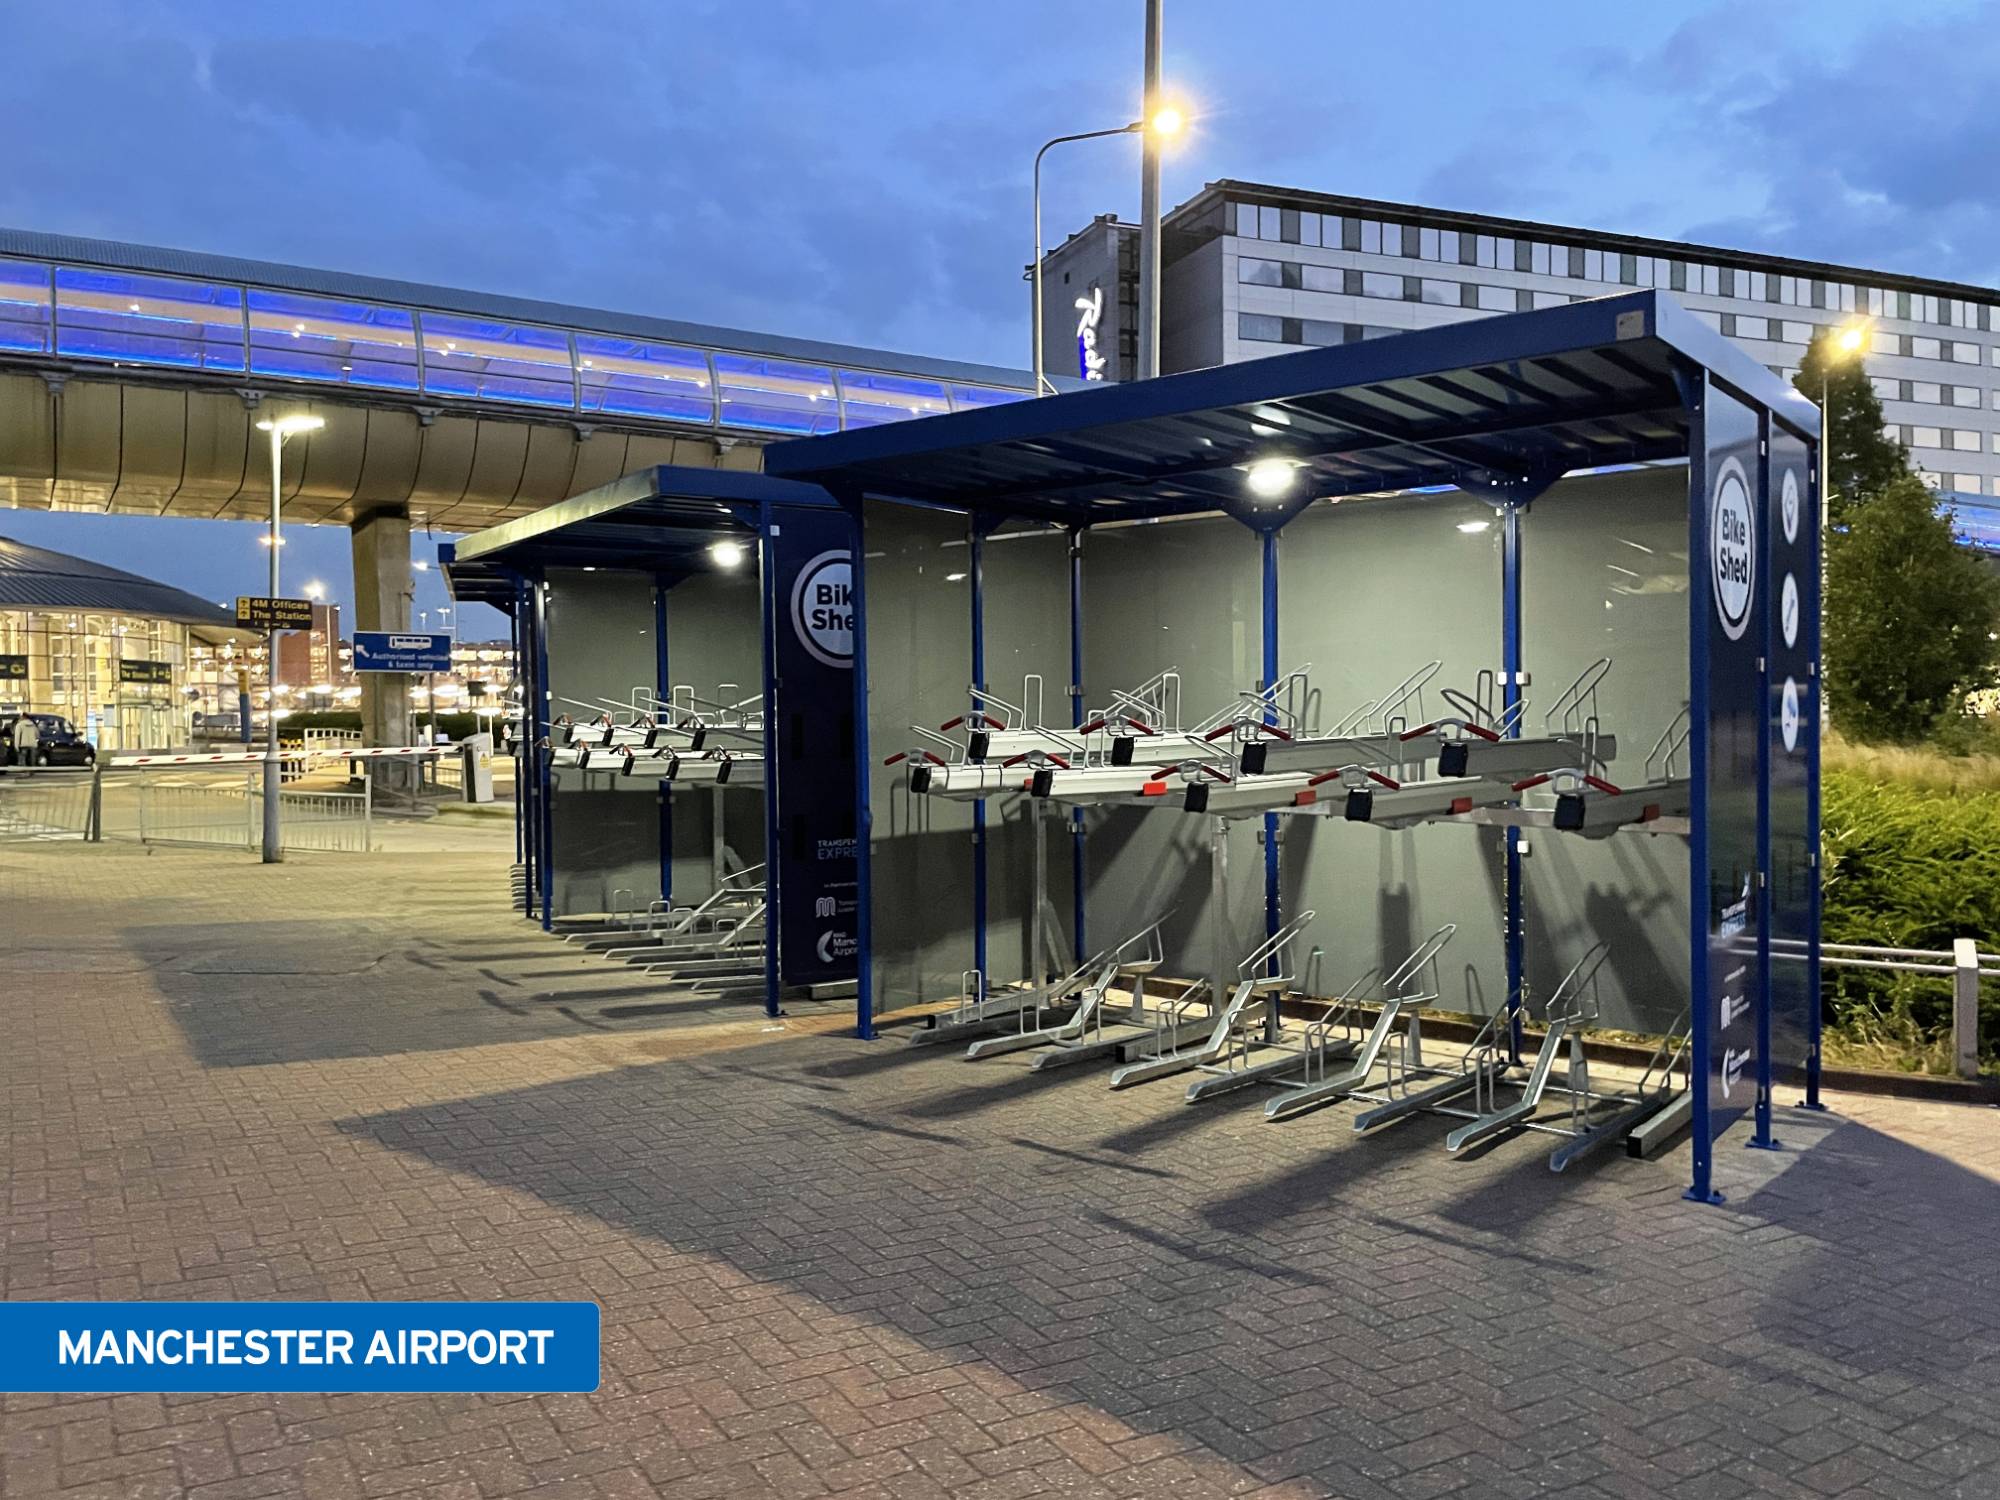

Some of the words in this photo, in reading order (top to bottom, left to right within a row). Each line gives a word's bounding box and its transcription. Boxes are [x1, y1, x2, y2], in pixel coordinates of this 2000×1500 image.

[1722, 509, 1746, 546] Bike
[1720, 548, 1747, 585] Shed
[251, 599, 268, 609] 4M
[271, 600, 310, 610] Offices
[252, 610, 271, 619] The
[275, 611, 312, 620] Station
